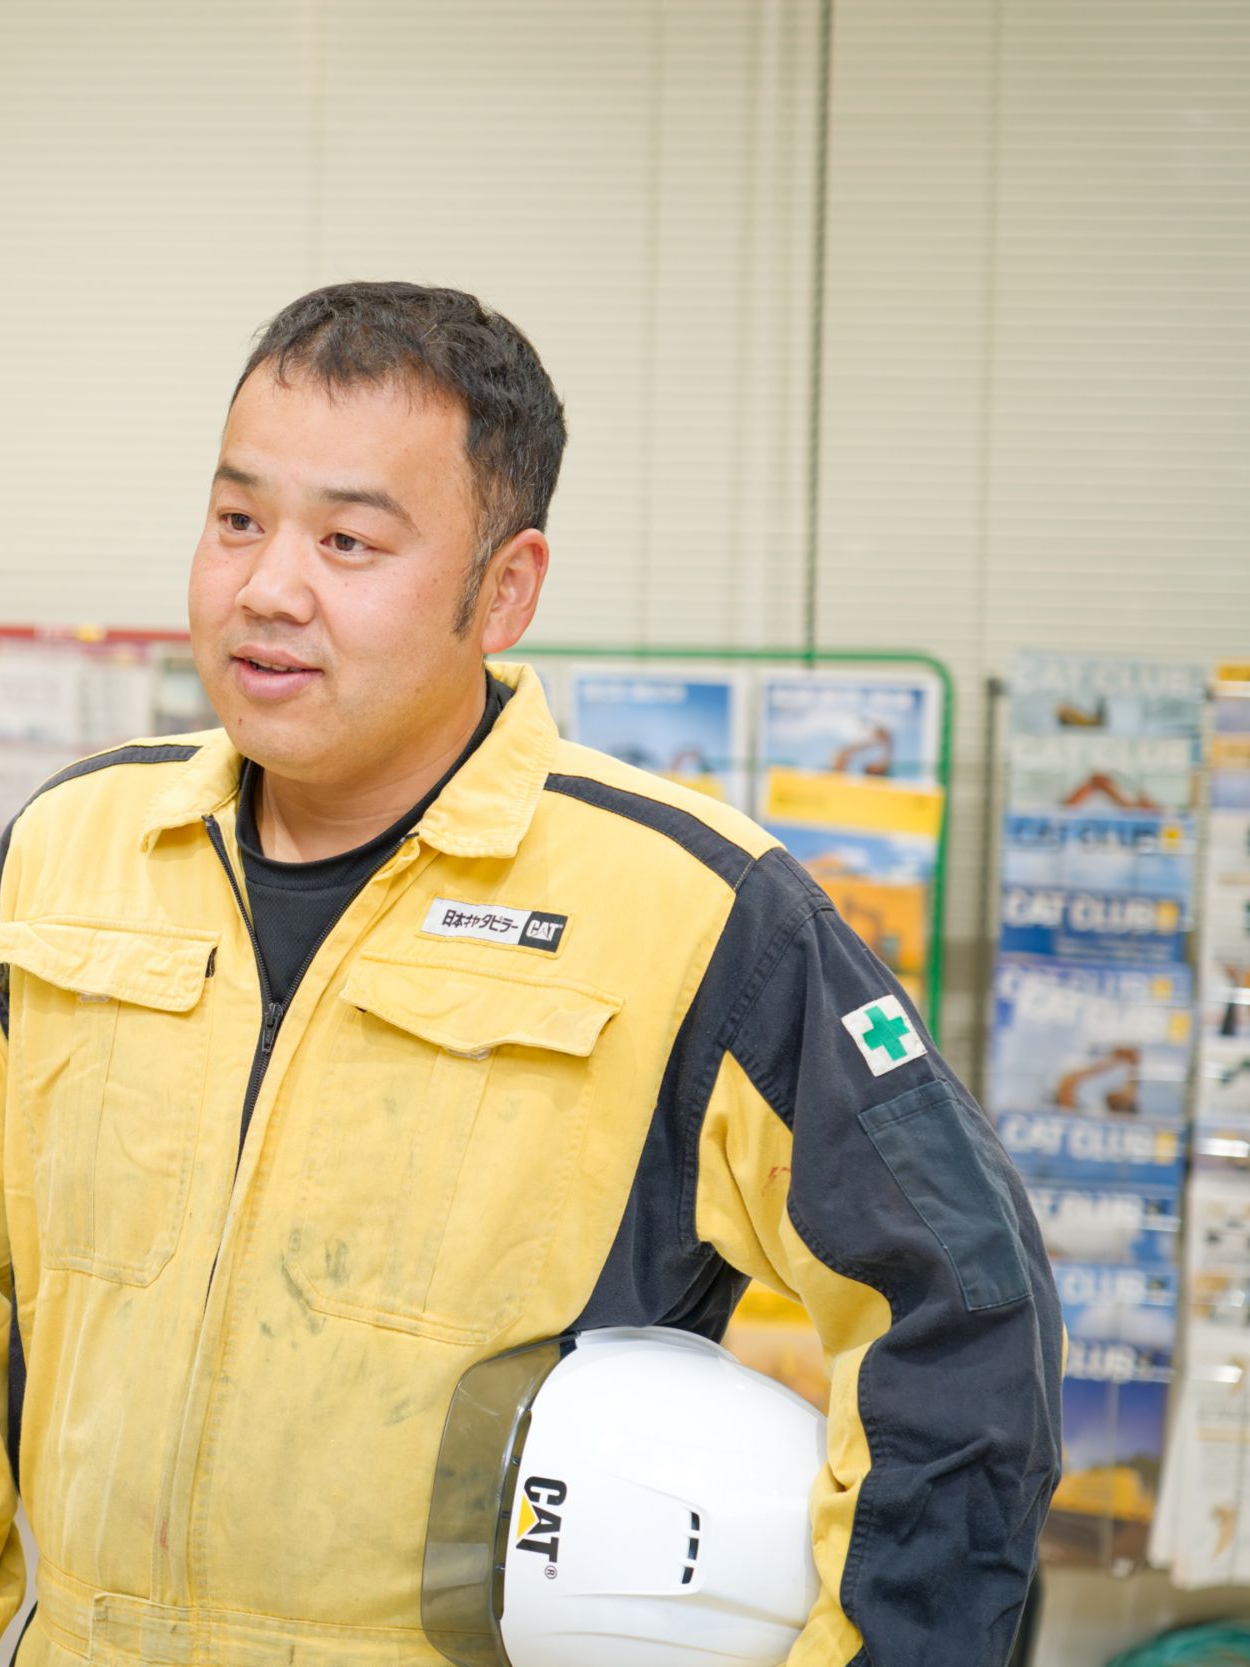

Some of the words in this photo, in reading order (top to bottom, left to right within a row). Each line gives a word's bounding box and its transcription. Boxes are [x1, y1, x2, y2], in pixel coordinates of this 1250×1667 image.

[442, 909, 519, 933] 日本キャタピラー
[1068, 1340, 1137, 1384] LUB
